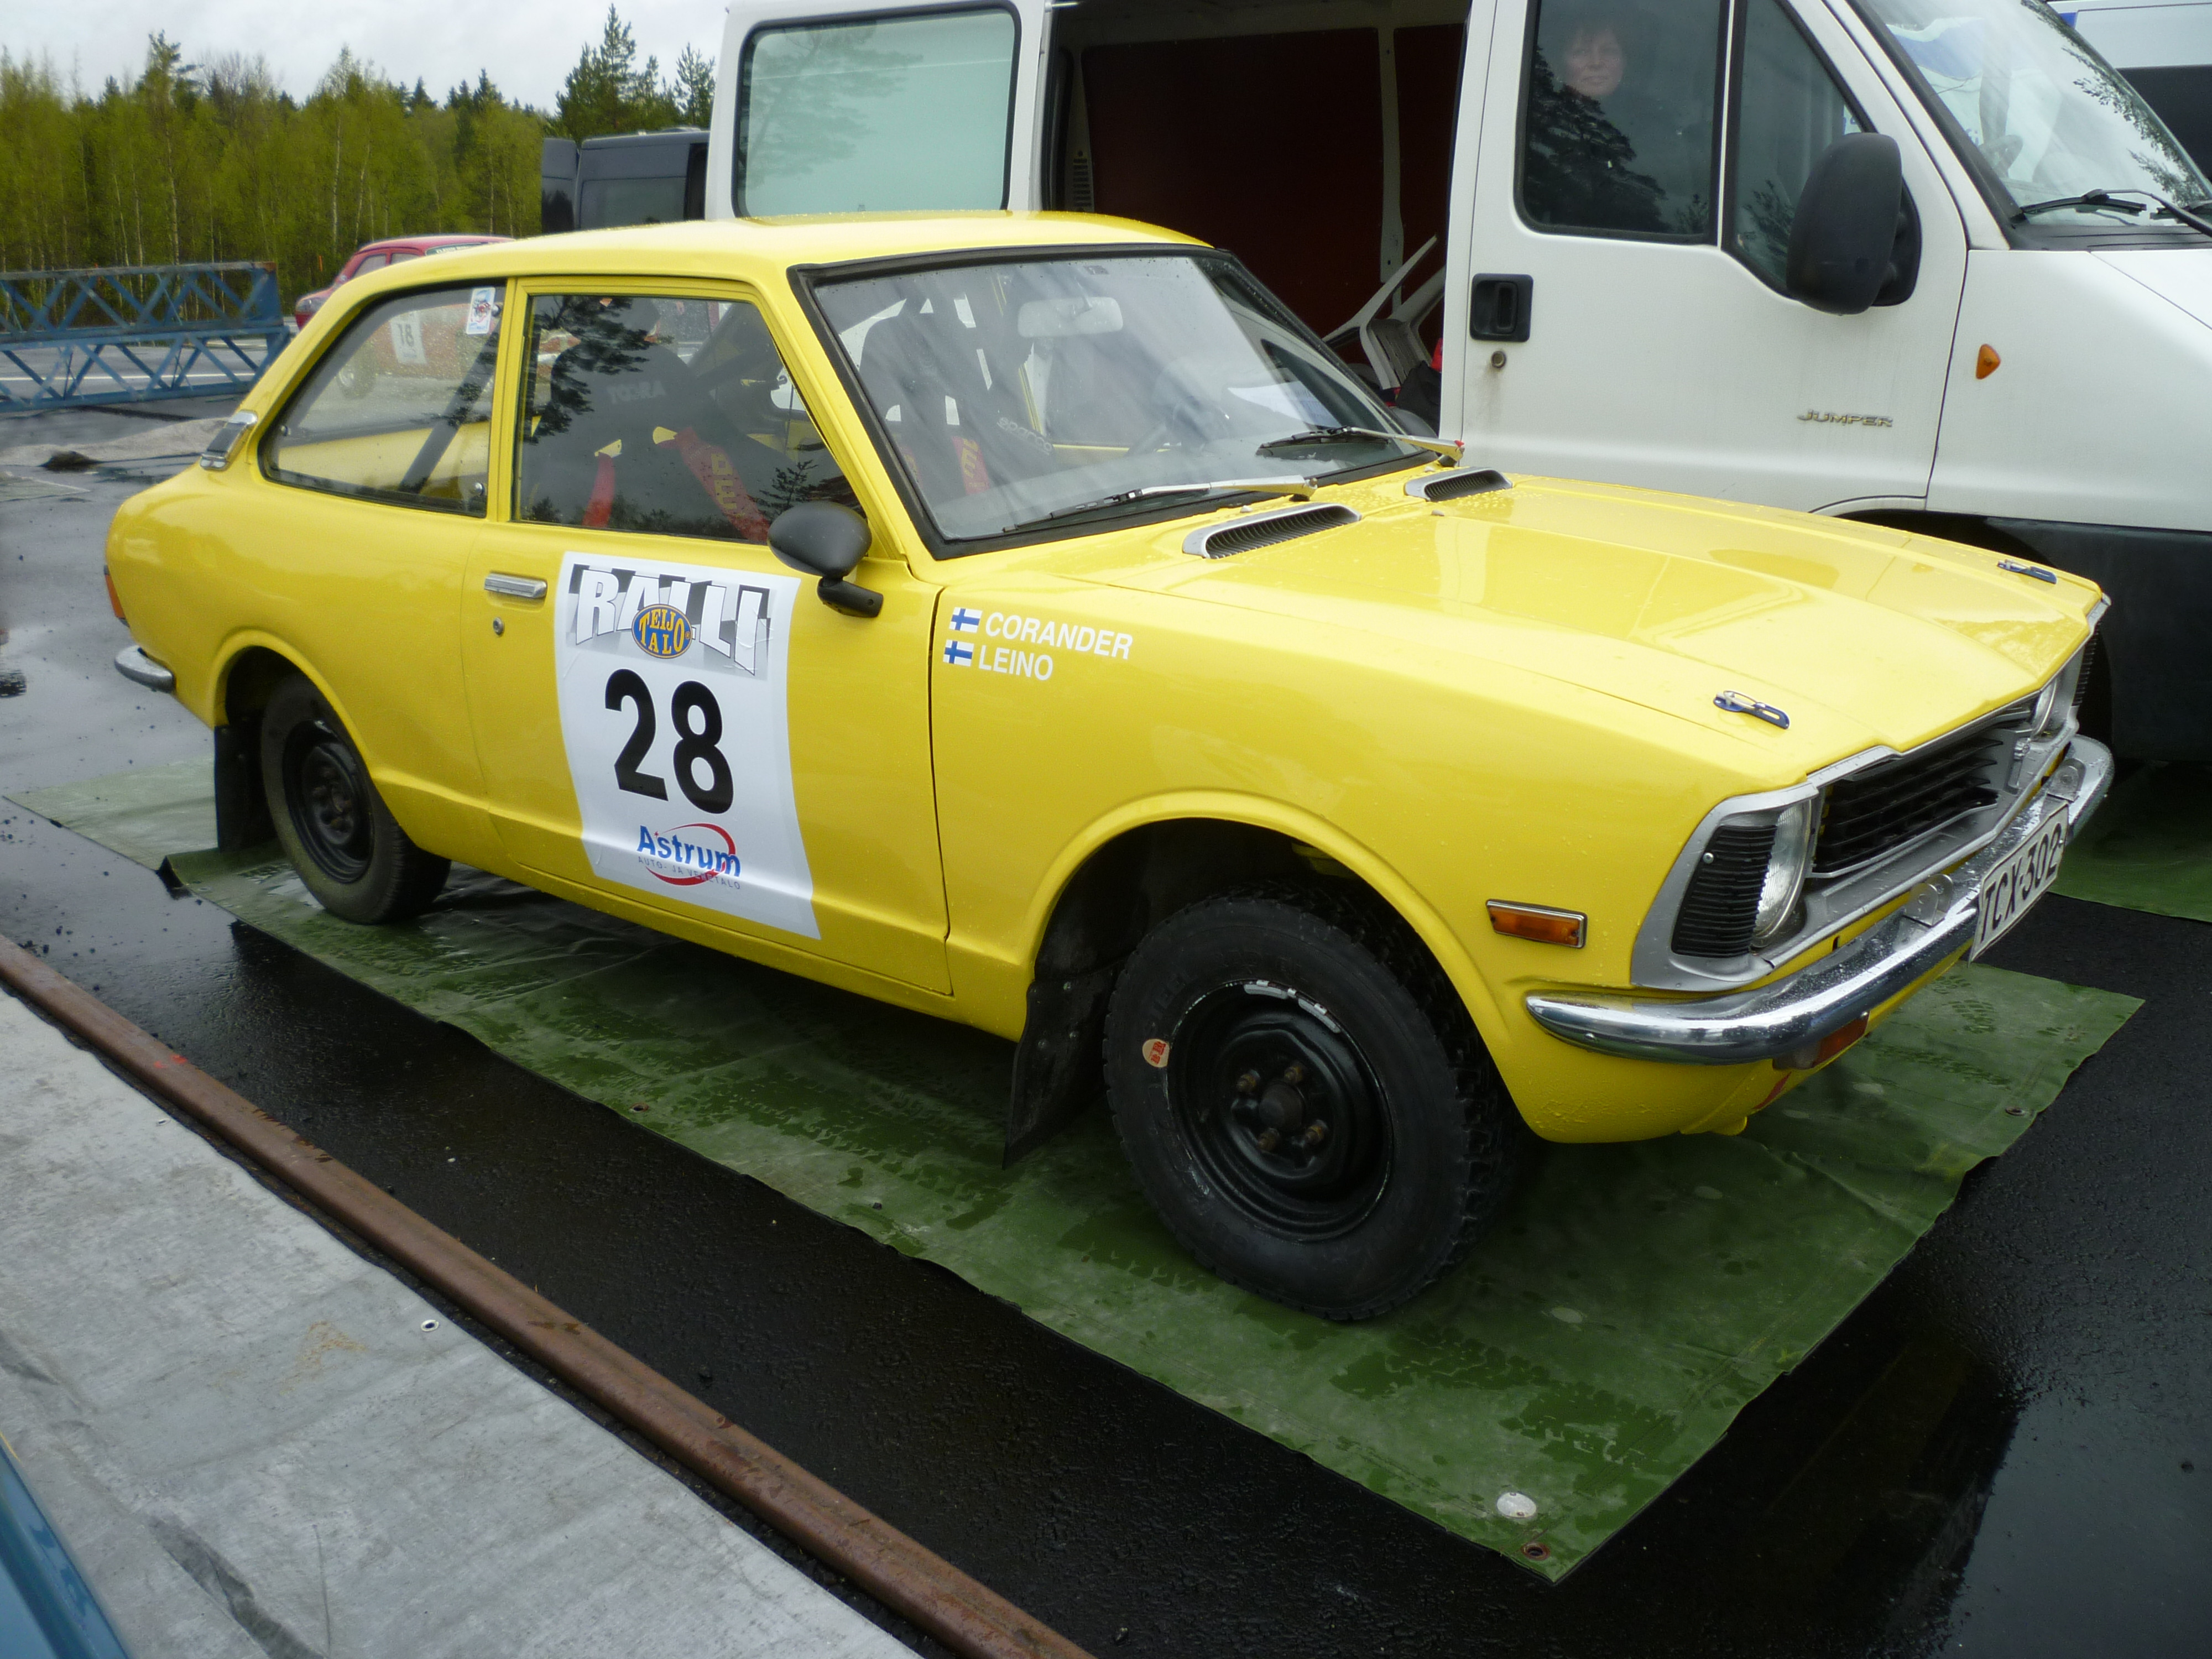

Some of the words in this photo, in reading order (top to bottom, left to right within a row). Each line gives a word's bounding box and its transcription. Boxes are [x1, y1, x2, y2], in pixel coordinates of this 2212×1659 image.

[1797, 409, 1893, 427] JUMPER
[985, 612, 1133, 659] CORANDER
[978, 644, 1053, 681] LEINO
[605, 668, 734, 814] 28
[637, 825, 740, 877] Astrum
[672, 865, 684, 874] JA
[1980, 823, 2062, 943] TCX-302
